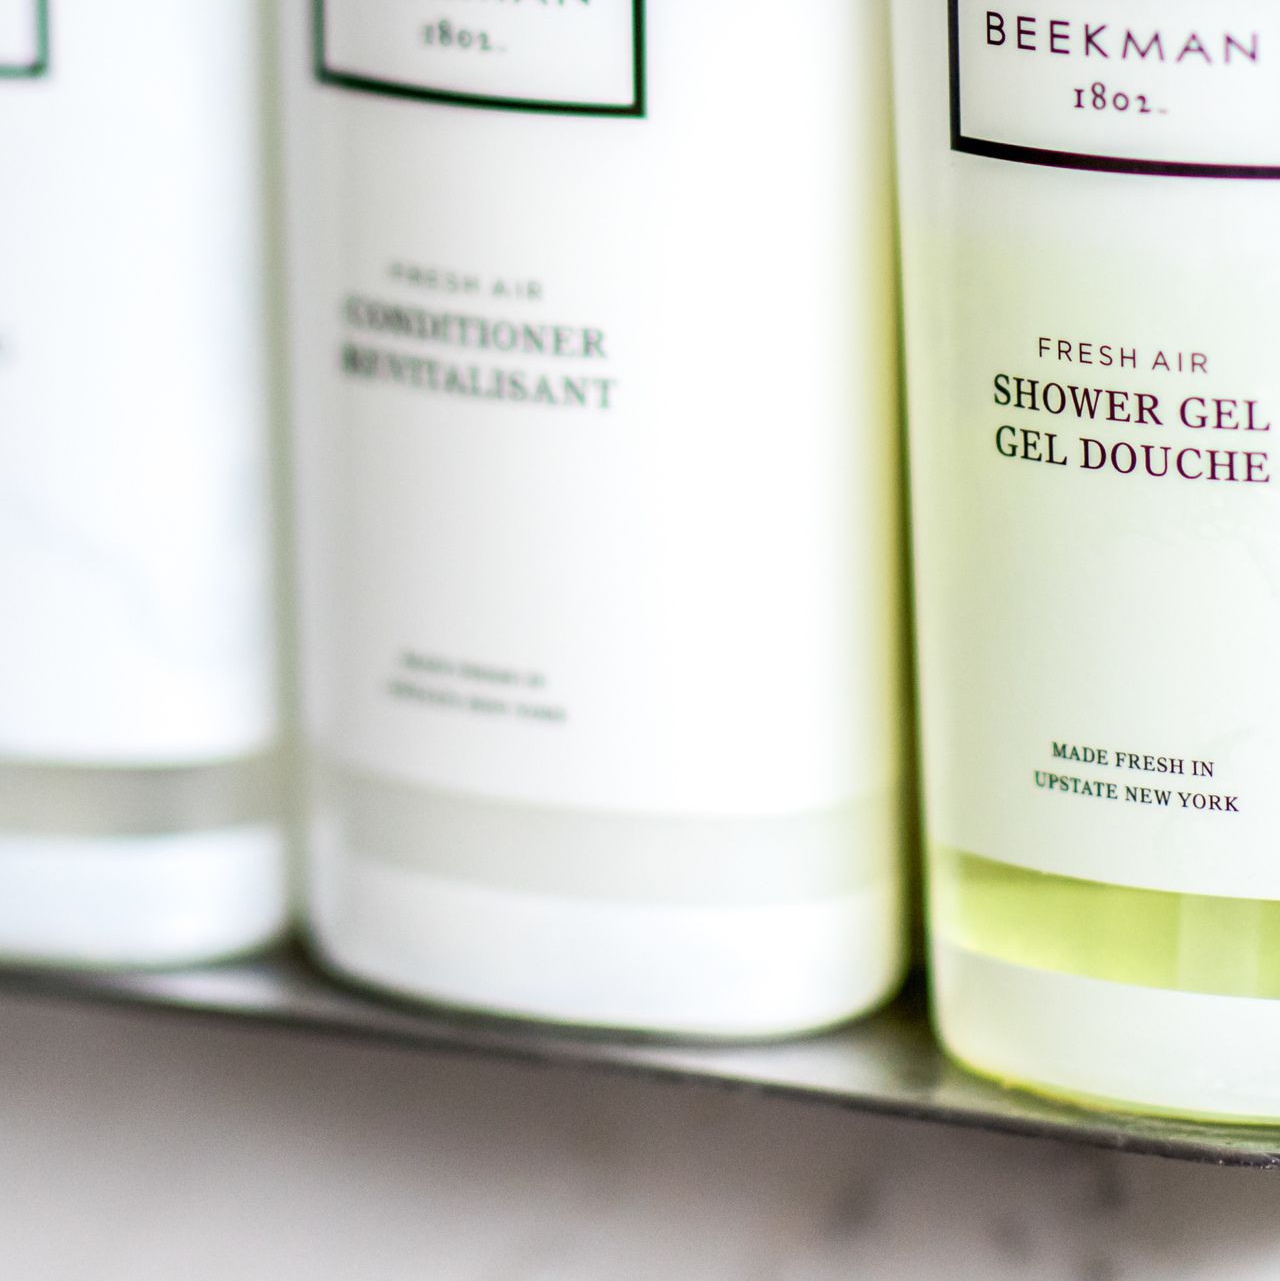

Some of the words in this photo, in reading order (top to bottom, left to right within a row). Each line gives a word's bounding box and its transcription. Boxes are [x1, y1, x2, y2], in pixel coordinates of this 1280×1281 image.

[985, 10, 1261, 65] BEEKMAN
[490, 279, 543, 301] AIR
[1037, 336, 1138, 369] FRESH
[1150, 350, 1210, 374] AIR
[992, 373, 1165, 426] SHOWER
[1178, 396, 1271, 432] GEL
[994, 424, 1069, 467] GEL
[1078, 437, 1271, 484] DOUCHE
[1051, 741, 1110, 766] MADE
[1114, 751, 1186, 775] FRESH
[1191, 760, 1215, 778] IN
[1034, 769, 1119, 800] UPSTATE
[1124, 786, 1172, 807] NEW
[1177, 791, 1241, 813] YORK
